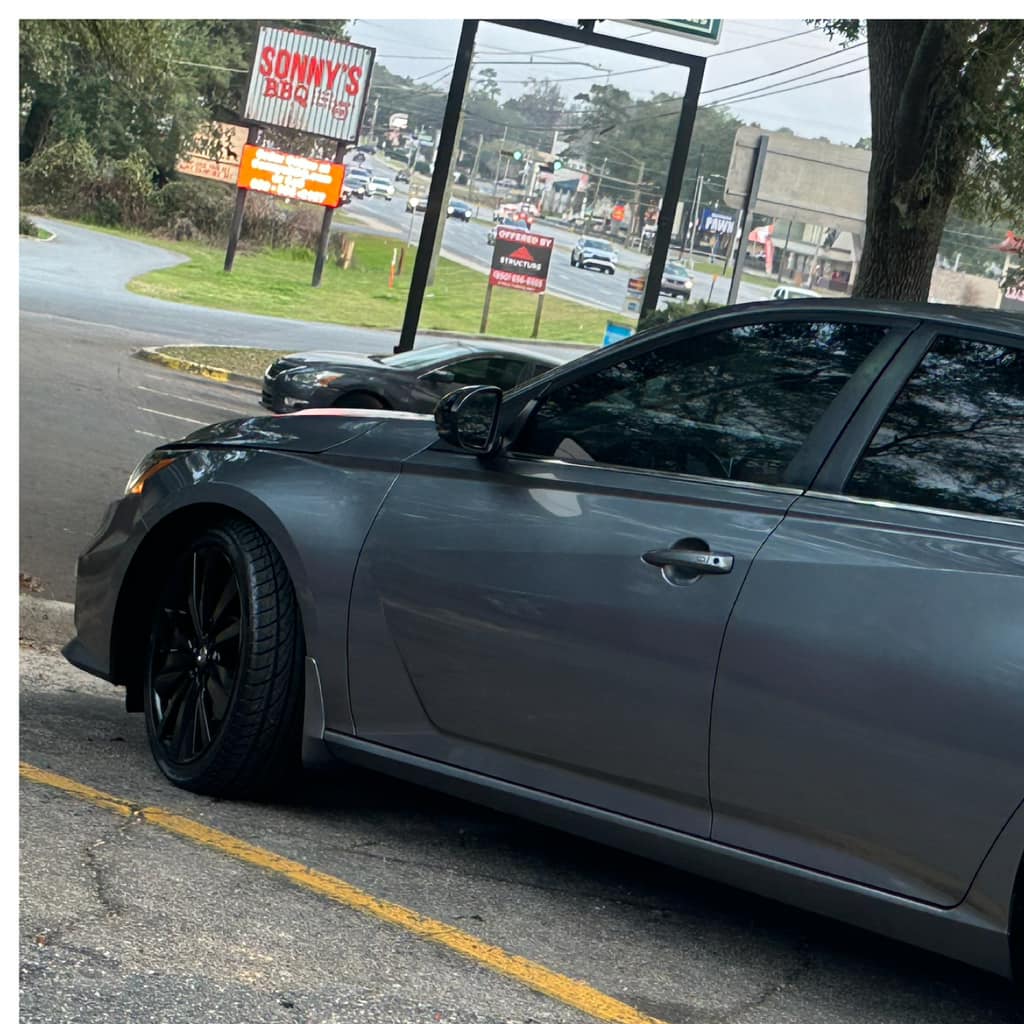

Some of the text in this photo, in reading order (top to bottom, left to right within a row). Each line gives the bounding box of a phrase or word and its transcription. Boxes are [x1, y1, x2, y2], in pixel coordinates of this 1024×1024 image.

[259, 46, 362, 96] SONNY'S
[264, 77, 308, 109] BBQ
[705, 216, 735, 234] PAWN
[498, 229, 553, 248] OFFERED BY
